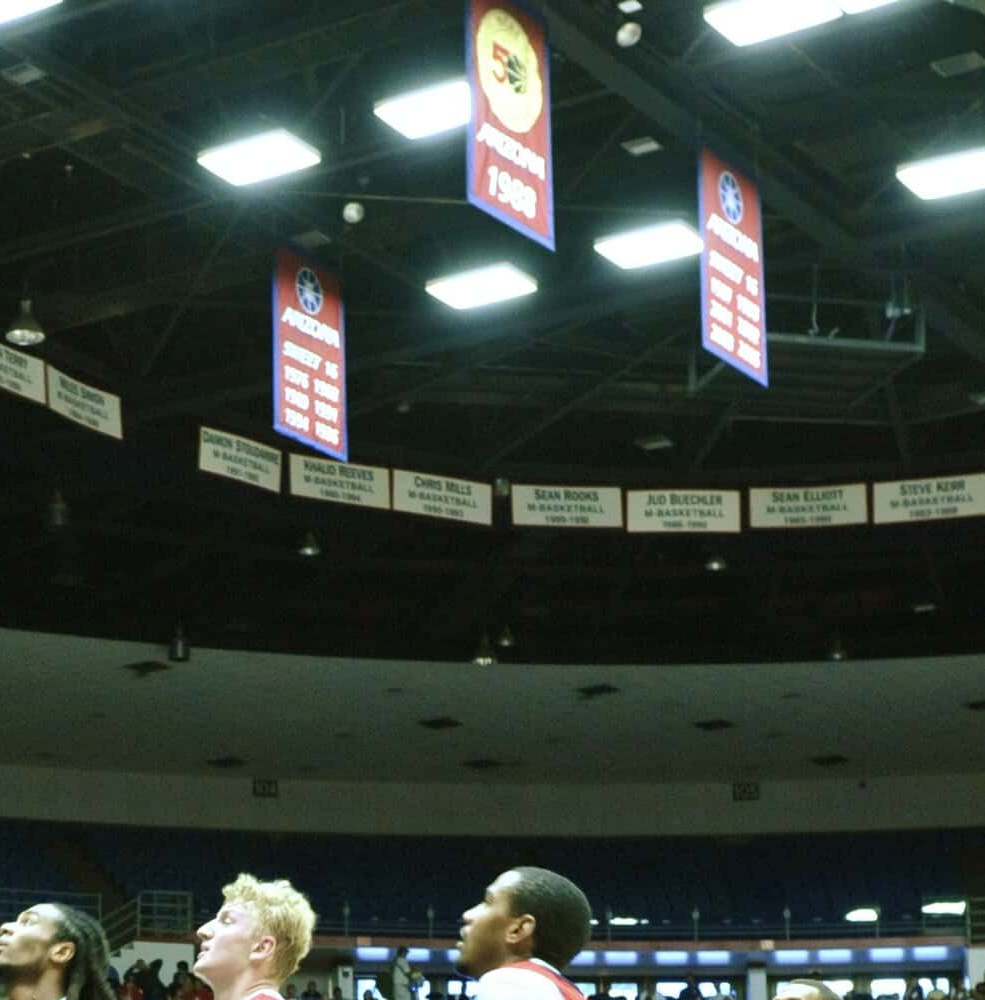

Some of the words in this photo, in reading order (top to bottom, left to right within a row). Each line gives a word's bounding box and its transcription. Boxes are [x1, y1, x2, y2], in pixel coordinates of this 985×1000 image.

[338, 463, 375, 482] REEVES
[303, 473, 375, 495] M-BASKETBALL
[414, 475, 443, 491] CHRIS
[445, 480, 473, 497] MILLS
[900, 482, 933, 497] STEVE
[935, 479, 966, 492] KERR
[408, 489, 477, 510] M-BASKETBALL
[533, 488, 562, 502] SEAN
[563, 488, 600, 502] ROOKS
[647, 493, 668, 507] JUD
[669, 493, 724, 507] BUECHLER
[772, 490, 800, 503] SEAN
[803, 488, 844, 502] ELLIOTT
[889, 494, 974, 509] M-BASKETBALL
[526, 503, 606, 515] M-BASKETBALL
[644, 507, 725, 519] M-BASKETBALL
[766, 502, 849, 515] M-BASKETBALL
